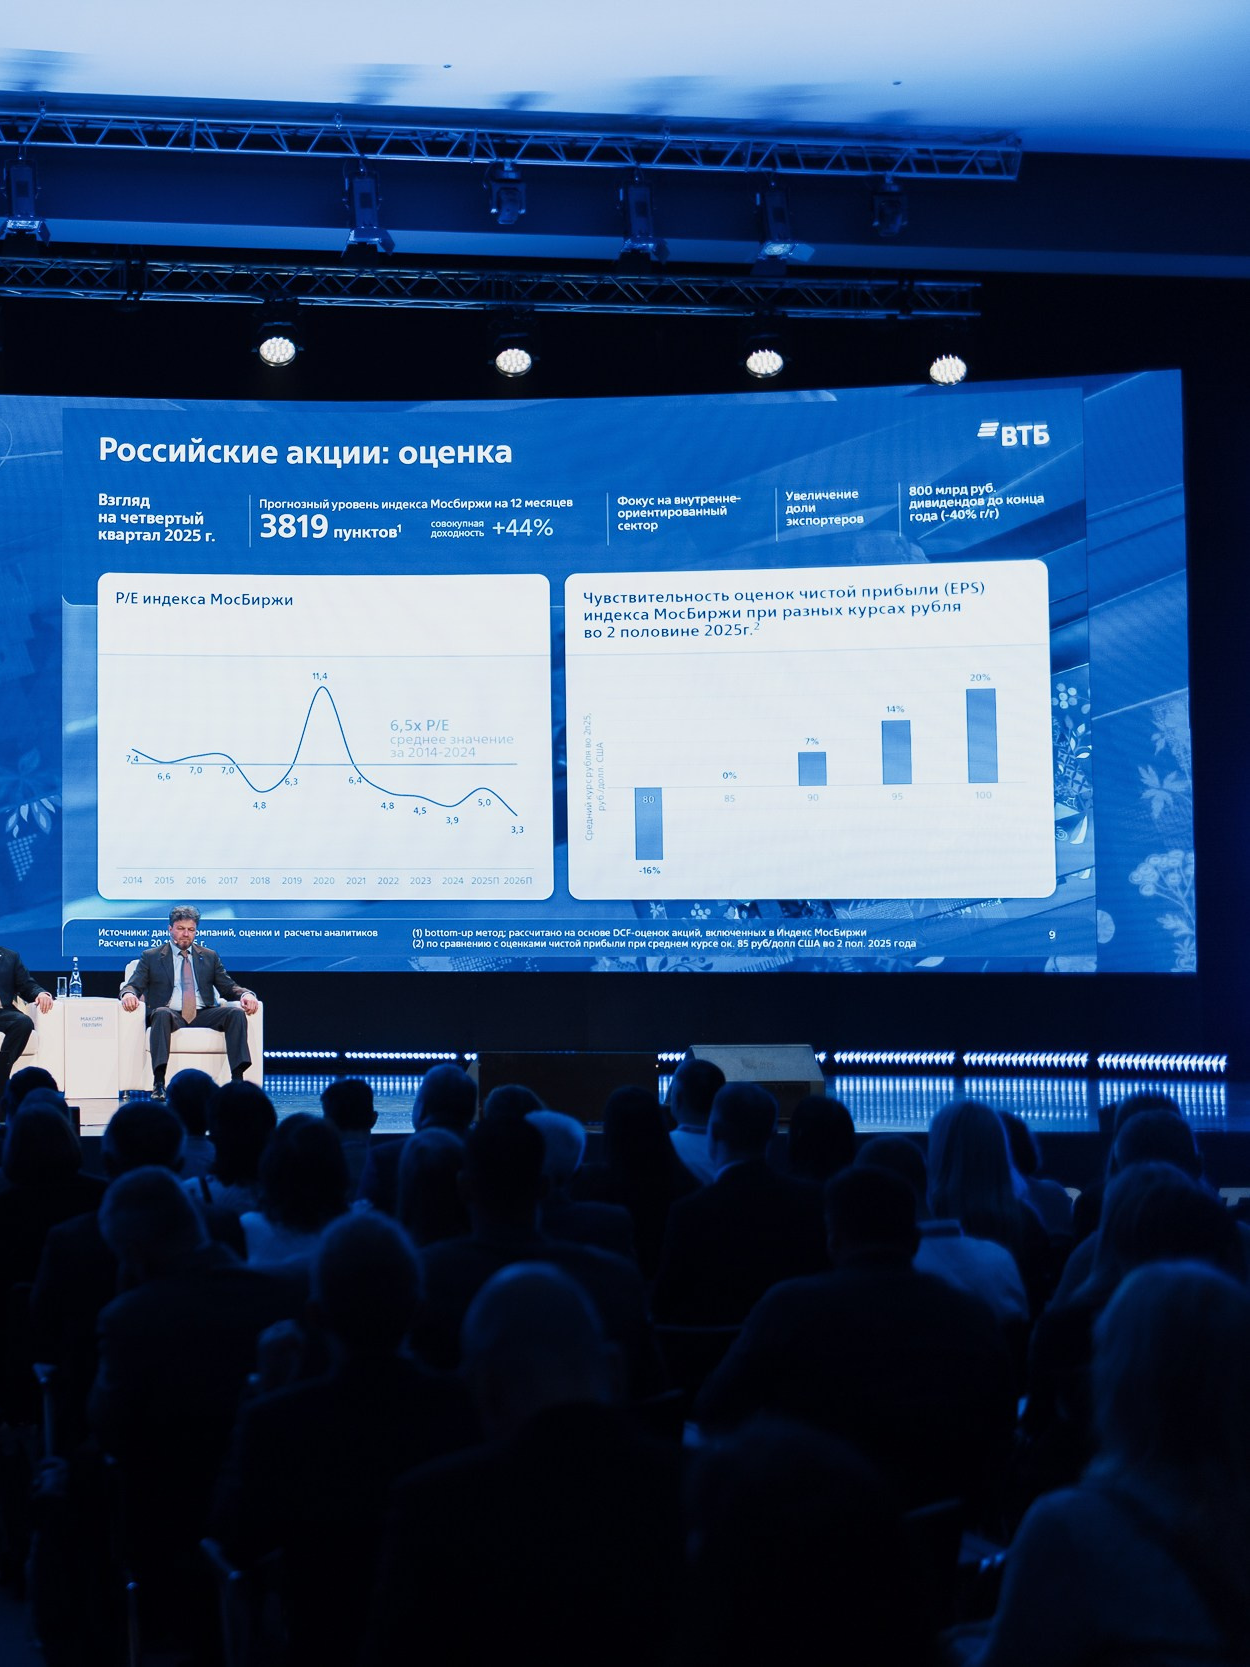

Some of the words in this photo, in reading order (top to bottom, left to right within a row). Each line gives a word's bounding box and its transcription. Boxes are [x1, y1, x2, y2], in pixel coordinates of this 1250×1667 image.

[1002, 424, 1050, 446] ВТБ
[100, 437, 278, 464] Российские
[287, 446, 388, 468] акции:
[399, 445, 512, 468] оценка
[909, 486, 932, 496] 800
[936, 486, 967, 498] млрд
[971, 483, 996, 496] руб.
[99, 493, 150, 509] Взгляд
[786, 491, 858, 501] Увеличение
[260, 499, 329, 510] Прогнозный
[331, 502, 379, 511] уровень
[382, 502, 428, 510] индекса
[431, 499, 491, 510] Мосбиржи
[510, 499, 522, 508] 12
[525, 500, 573, 508] месяцев
[617, 496, 650, 510] Фокус
[654, 497, 671, 505] на
[674, 496, 741, 506] внутренне-
[786, 502, 815, 514] доли
[909, 498, 985, 511] дивидендов
[987, 497, 1003, 508] до
[1006, 496, 1044, 504] конца
[618, 506, 727, 520] ориентированный
[910, 513, 938, 522] года
[939, 509, 977, 521] (-40%
[980, 508, 999, 519] г/г)
[99, 514, 116, 523] на
[121, 512, 203, 527] четвертый
[786, 515, 864, 527] экспортеров
[261, 514, 328, 538] 3819
[431, 521, 484, 529] совокупная
[493, 519, 553, 536] +44%
[618, 521, 658, 532] сектор
[99, 531, 160, 544] квартал
[165, 529, 201, 541] 2025
[206, 533, 215, 541] г.
[431, 529, 484, 538] доходность
[584, 593, 729, 604] Чувствительность
[735, 592, 794, 602] оценок
[800, 586, 855, 598] чистой
[862, 584, 939, 601] прибыли
[945, 582, 984, 596] (EPS)
[144, 596, 205, 606] индекса
[211, 594, 292, 608] МосБиржи
[585, 608, 648, 623] индекса
[655, 608, 740, 622] МосБиржи
[747, 609, 776, 621] при
[783, 608, 842, 620] разных
[849, 606, 904, 618] курсах
[912, 600, 960, 616] рубля
[585, 630, 602, 638] во
[608, 626, 614, 638] 2
[621, 628, 699, 637] половине
[391, 737, 446, 745] среднее
[451, 736, 513, 744] значение
[408, 747, 475, 757] 2014-2024
[127, 755, 139, 764] 7,4
[189, 766, 202, 774] 7,0
[221, 766, 234, 774] 7,0
[158, 773, 170, 781] 6,6
[285, 778, 297, 786] 6,3
[976, 791, 992, 799] 100
[381, 802, 394, 810] 4,8
[478, 799, 491, 807] 5,0
[414, 807, 426, 815] 4,5
[511, 826, 523, 834] 3,3
[99, 929, 149, 938] Источники:
[196, 928, 236, 938] омпаний,
[413, 929, 422, 938] (1)
[425, 929, 473, 938] bottom-up
[509, 930, 562, 938] рассчитано
[613, 929, 669, 938] DCF-оценок
[672, 929, 702, 938] акций,
[706, 930, 766, 938] включенных
[777, 929, 811, 938] Индекс
[814, 929, 867, 939] МосБиржи
[1049, 931, 1055, 939] 9
[99, 939, 137, 947] Расчеты
[413, 939, 424, 948] (2)
[440, 941, 491, 949] сравнению
[584, 939, 627, 949] прибыли
[628, 941, 646, 949] при
[648, 941, 688, 949] среднем
[691, 941, 720, 949] курсе
[751, 939, 795, 949] руб/долл
[868, 939, 891, 947] 2025
[894, 941, 916, 949] года
